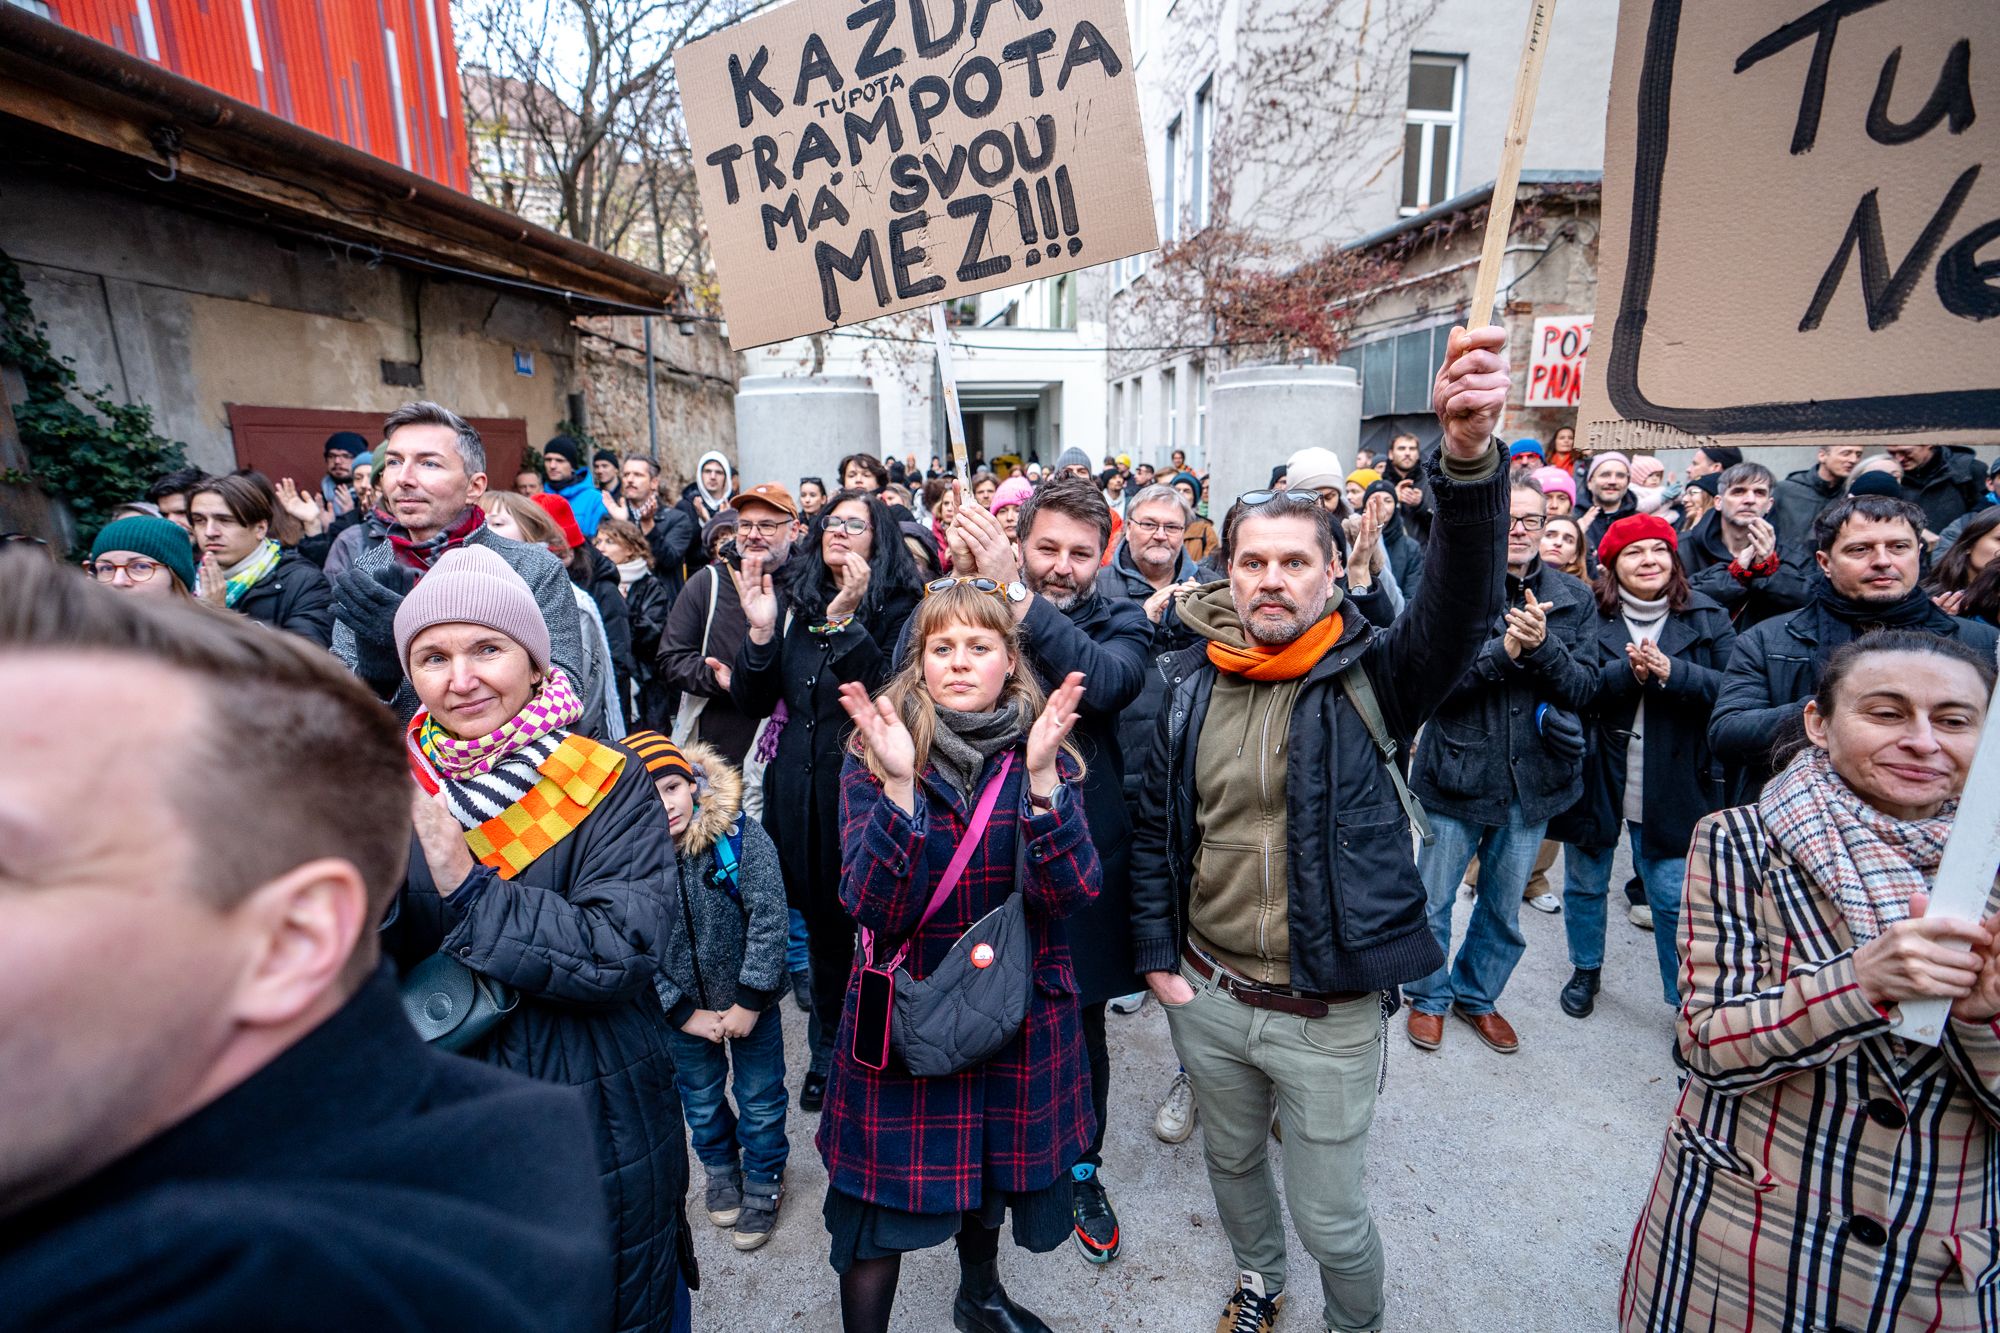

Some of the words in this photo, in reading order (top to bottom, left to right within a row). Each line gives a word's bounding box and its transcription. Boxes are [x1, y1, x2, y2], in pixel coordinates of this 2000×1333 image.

[706, 20, 1122, 205] TRAMPOTA
[814, 73, 905, 118] TUPOTA
[889, 113, 1056, 213] SVOU
[815, 164, 1082, 323] MEZ!!!
